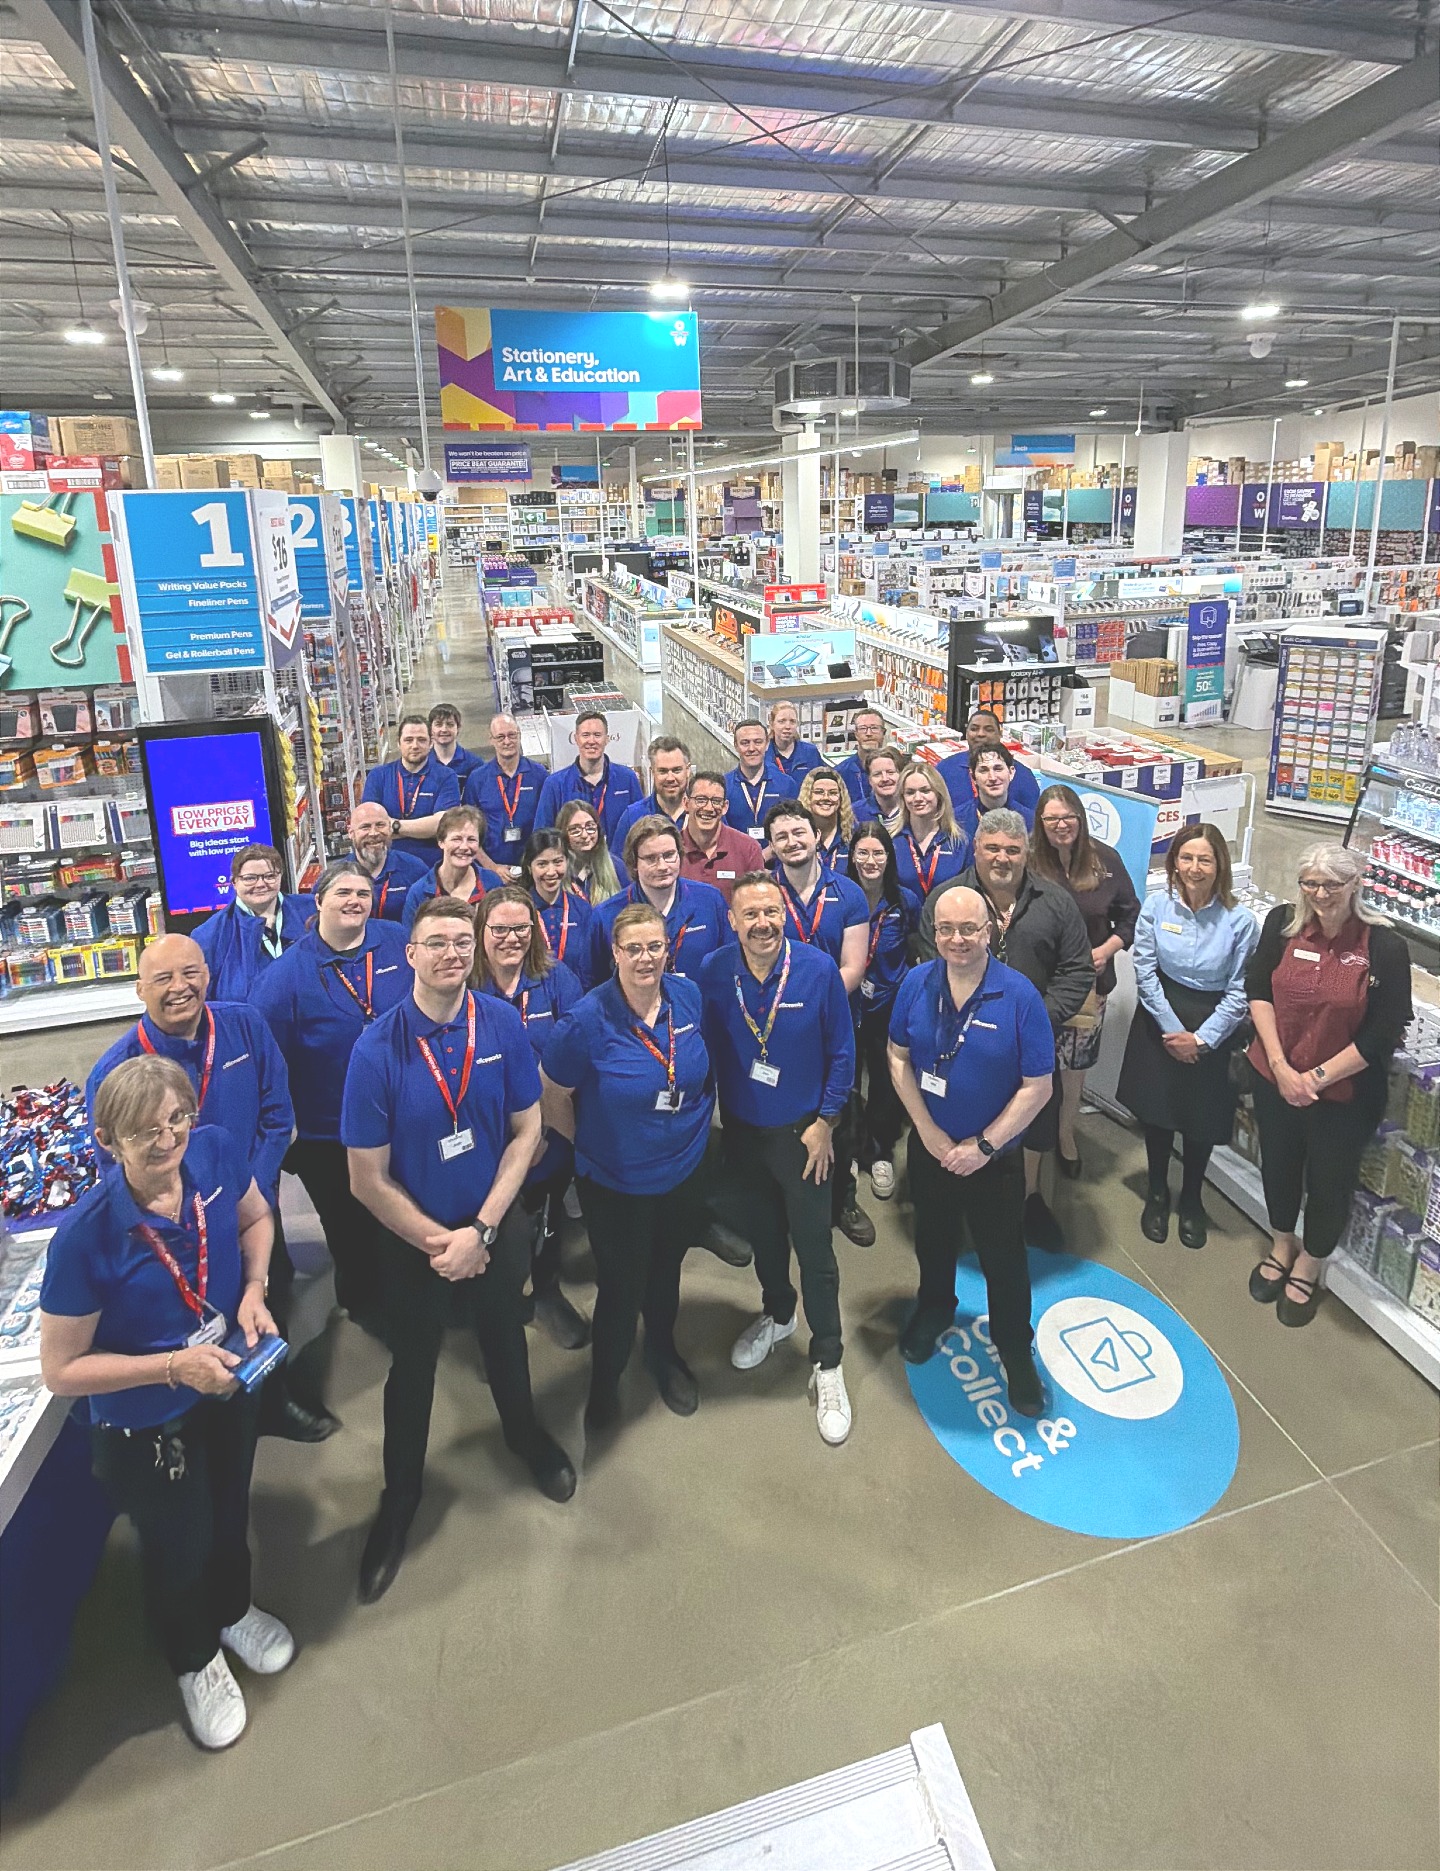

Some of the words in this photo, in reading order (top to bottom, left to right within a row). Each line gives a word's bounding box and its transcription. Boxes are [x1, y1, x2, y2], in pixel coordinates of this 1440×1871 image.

[502, 347, 600, 368] Stationery,
[503, 366, 533, 382] Art
[535, 367, 549, 382] &
[552, 368, 641, 383] Education
[287, 504, 318, 548] 2
[191, 503, 244, 568] 1
[158, 581, 191, 592] Writing
[193, 581, 219, 591] Value
[220, 580, 247, 589] Packs
[188, 598, 226, 607] Fineliner
[227, 597, 249, 606] Pens
[190, 632, 230, 641] Premium
[232, 630, 253, 639] Pens
[166, 650, 181, 660] Gel
[183, 650, 190, 659] &
[191, 648, 233, 659] Rollerball
[234, 647, 255, 656] Pens
[1405, 779, 1433, 795] Cold
[177, 809, 205, 820] LOW
[207, 805, 249, 818] PRICES
[1157, 811, 1180, 823] CES
[178, 817, 220, 830] EVERY
[223, 814, 249, 826] DAY
[189, 840, 204, 849] Big
[205, 838, 228, 847] ideas
[229, 836, 250, 844] start
[189, 849, 208, 857] with
[935, 1326, 1045, 1478] Collect
[1036, 1416, 1077, 1456] &
